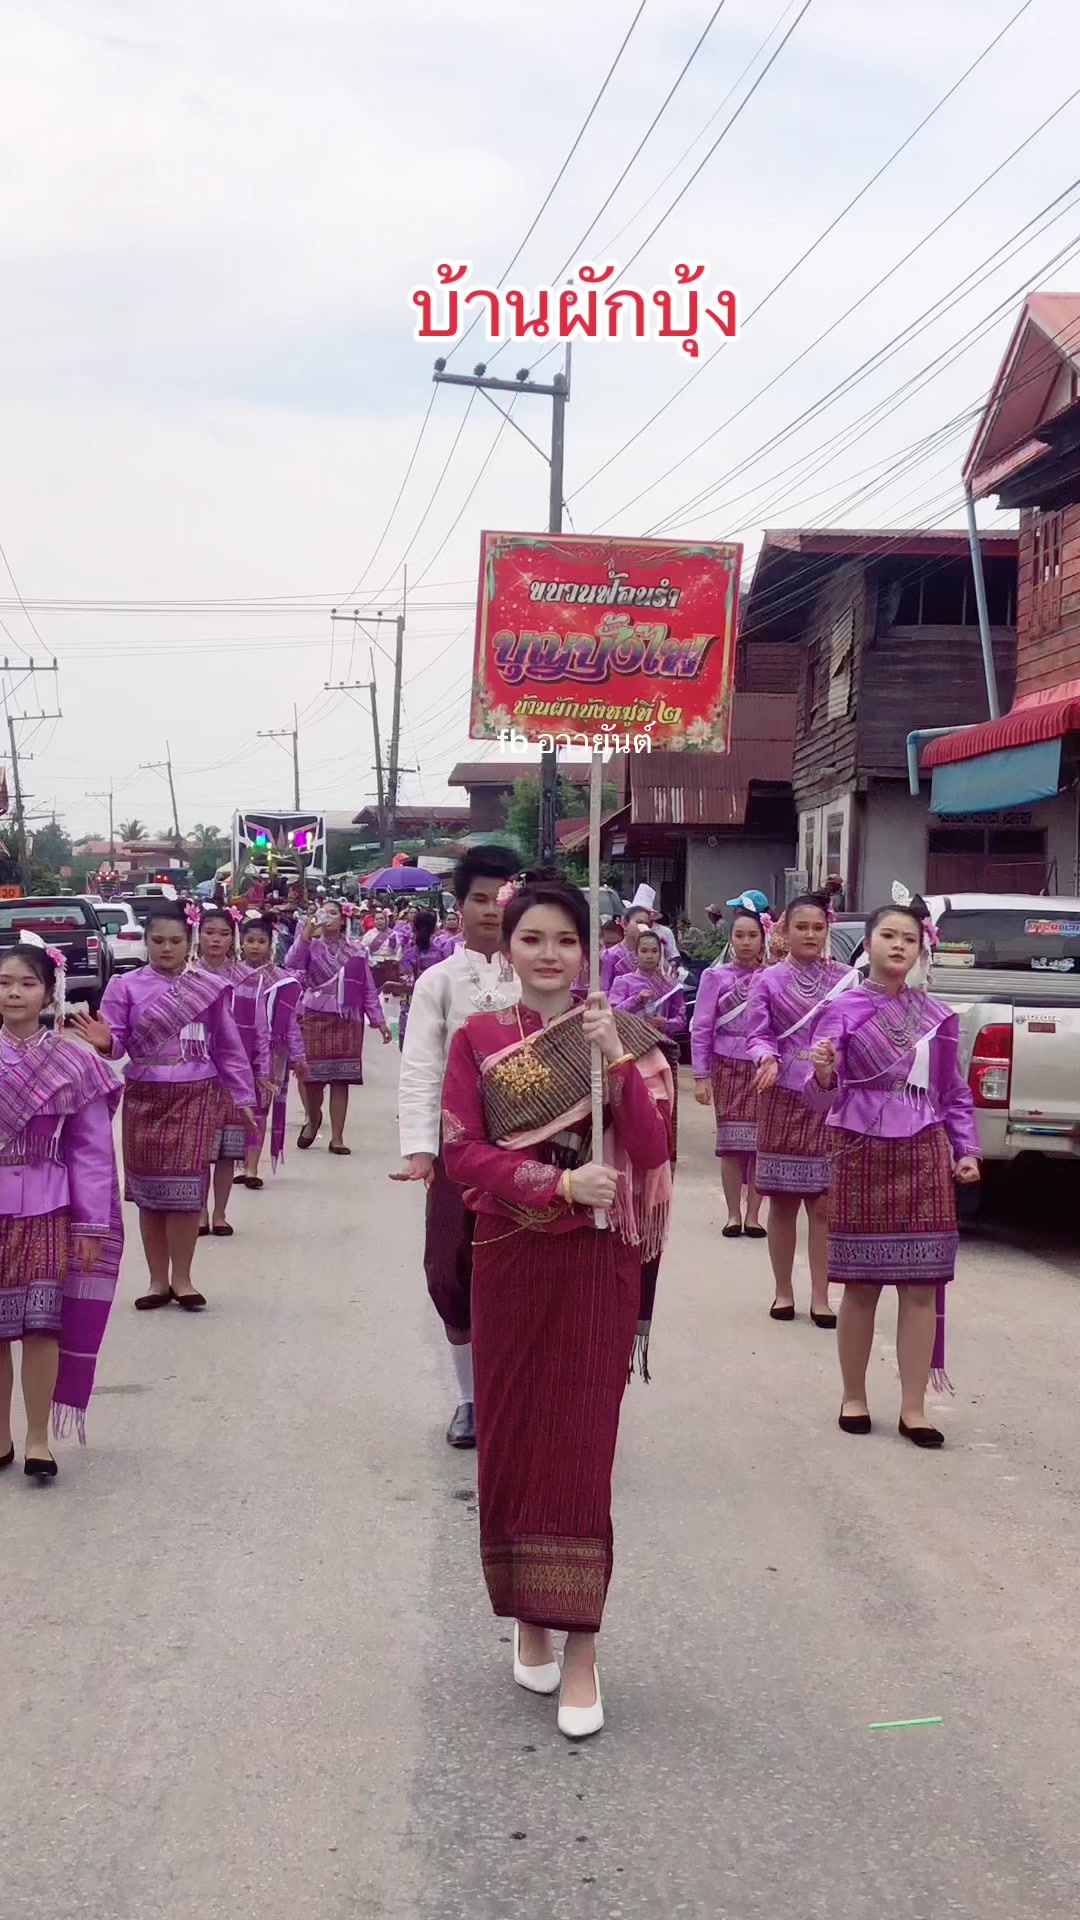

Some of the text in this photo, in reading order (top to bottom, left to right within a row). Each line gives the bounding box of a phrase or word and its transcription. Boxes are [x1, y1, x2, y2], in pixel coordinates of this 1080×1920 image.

[529, 569, 681, 608] ขบวนฟ้อนรำ
[492, 611, 717, 683] บุญบั้งไฟ
